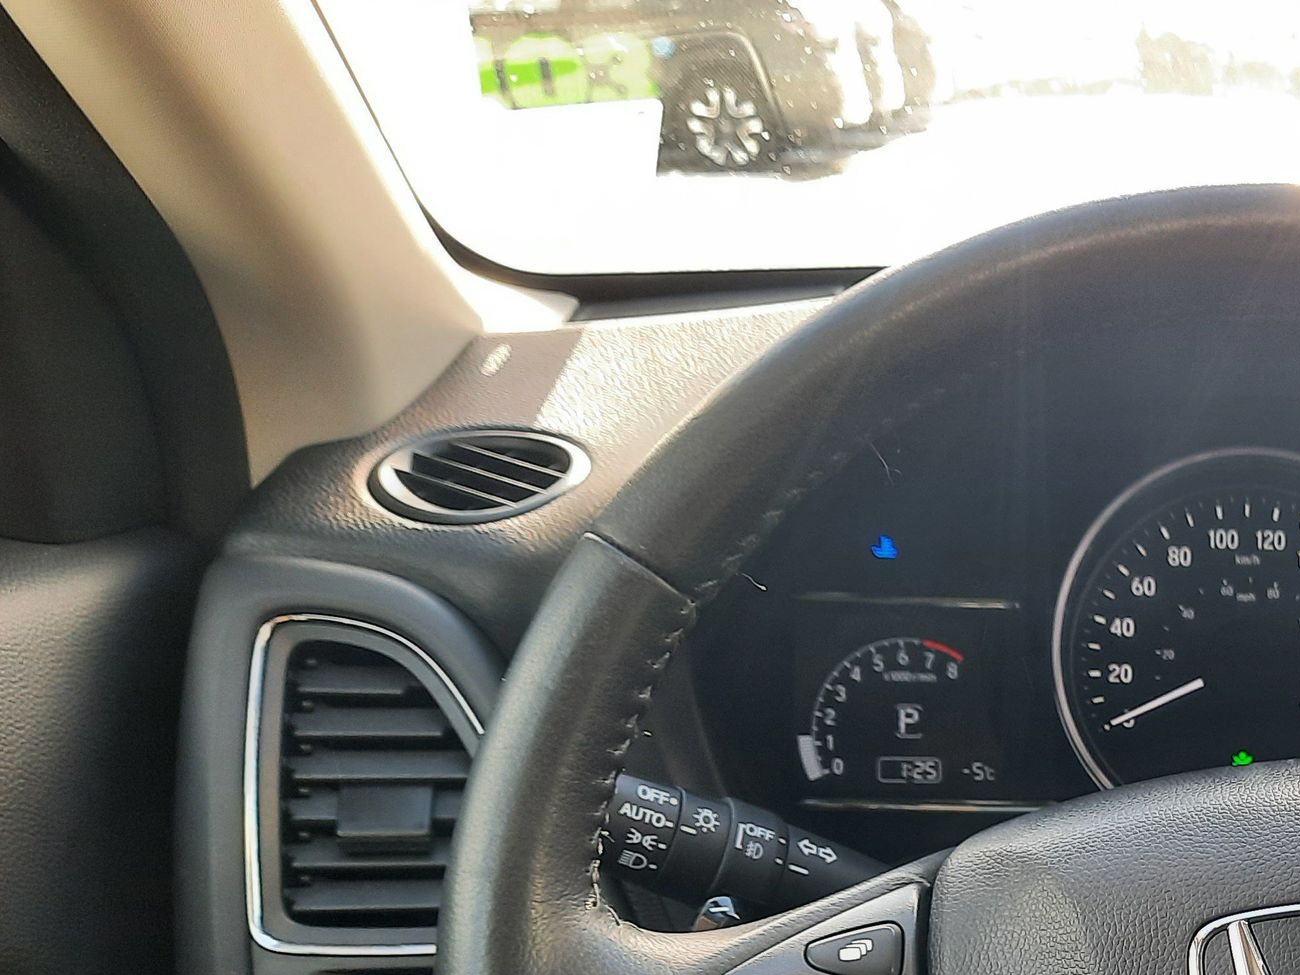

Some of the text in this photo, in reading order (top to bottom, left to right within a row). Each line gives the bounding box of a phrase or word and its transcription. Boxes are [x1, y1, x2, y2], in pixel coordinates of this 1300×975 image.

[1208, 528, 1239, 550] 100
[1256, 530, 1286, 551] 120
[1167, 545, 1192, 567] 80
[1131, 576, 1156, 597] 60
[1109, 617, 1136, 638] 40
[872, 653, 884, 672] 5
[923, 651, 935, 670] 7
[850, 665, 861, 682] 4
[946, 661, 958, 680] 8
[1108, 663, 1133, 684] 20
[834, 684, 847, 702] 3
[824, 708, 836, 726] 2
[826, 734, 834, 751] 1
[831, 757, 844, 775] 0
[637, 784, 669, 805] OFF
[619, 802, 666, 828] AUTO
[746, 823, 776, 841] OFF
